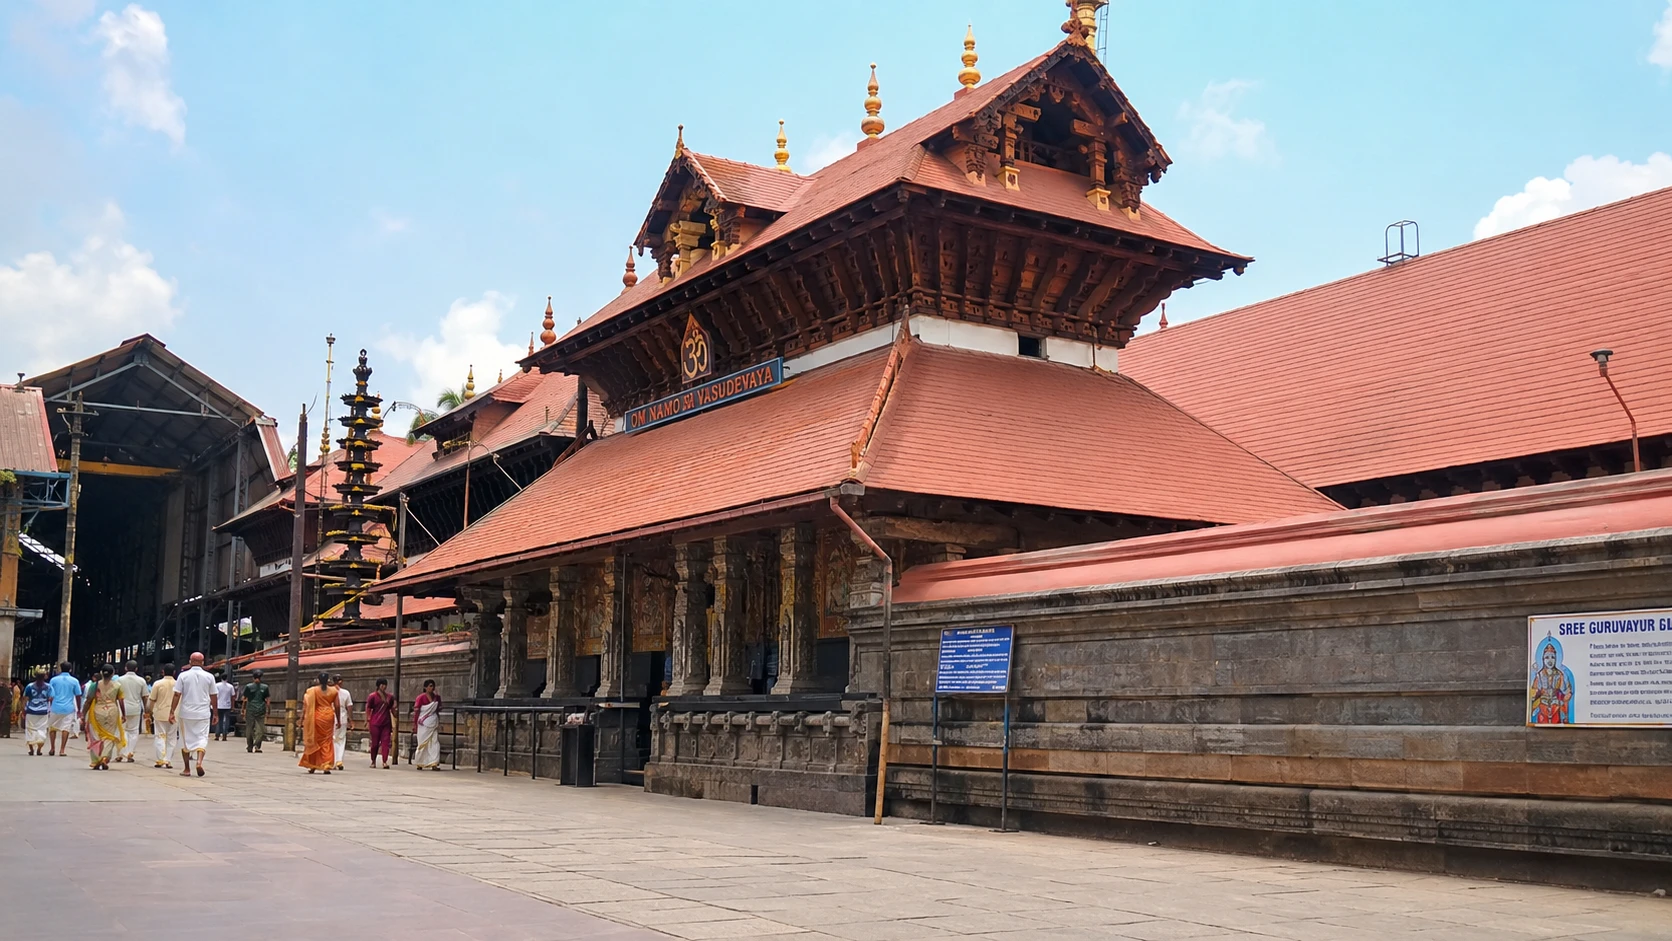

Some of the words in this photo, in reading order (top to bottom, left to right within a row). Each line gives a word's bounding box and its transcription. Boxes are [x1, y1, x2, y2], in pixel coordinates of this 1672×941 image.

[631, 408, 646, 428] OM
[649, 398, 680, 422] NAMO
[697, 366, 773, 406] VASUDEVAYA
[1559, 622, 1586, 636] SREE
[1589, 618, 1655, 635] GURUVAYUR
